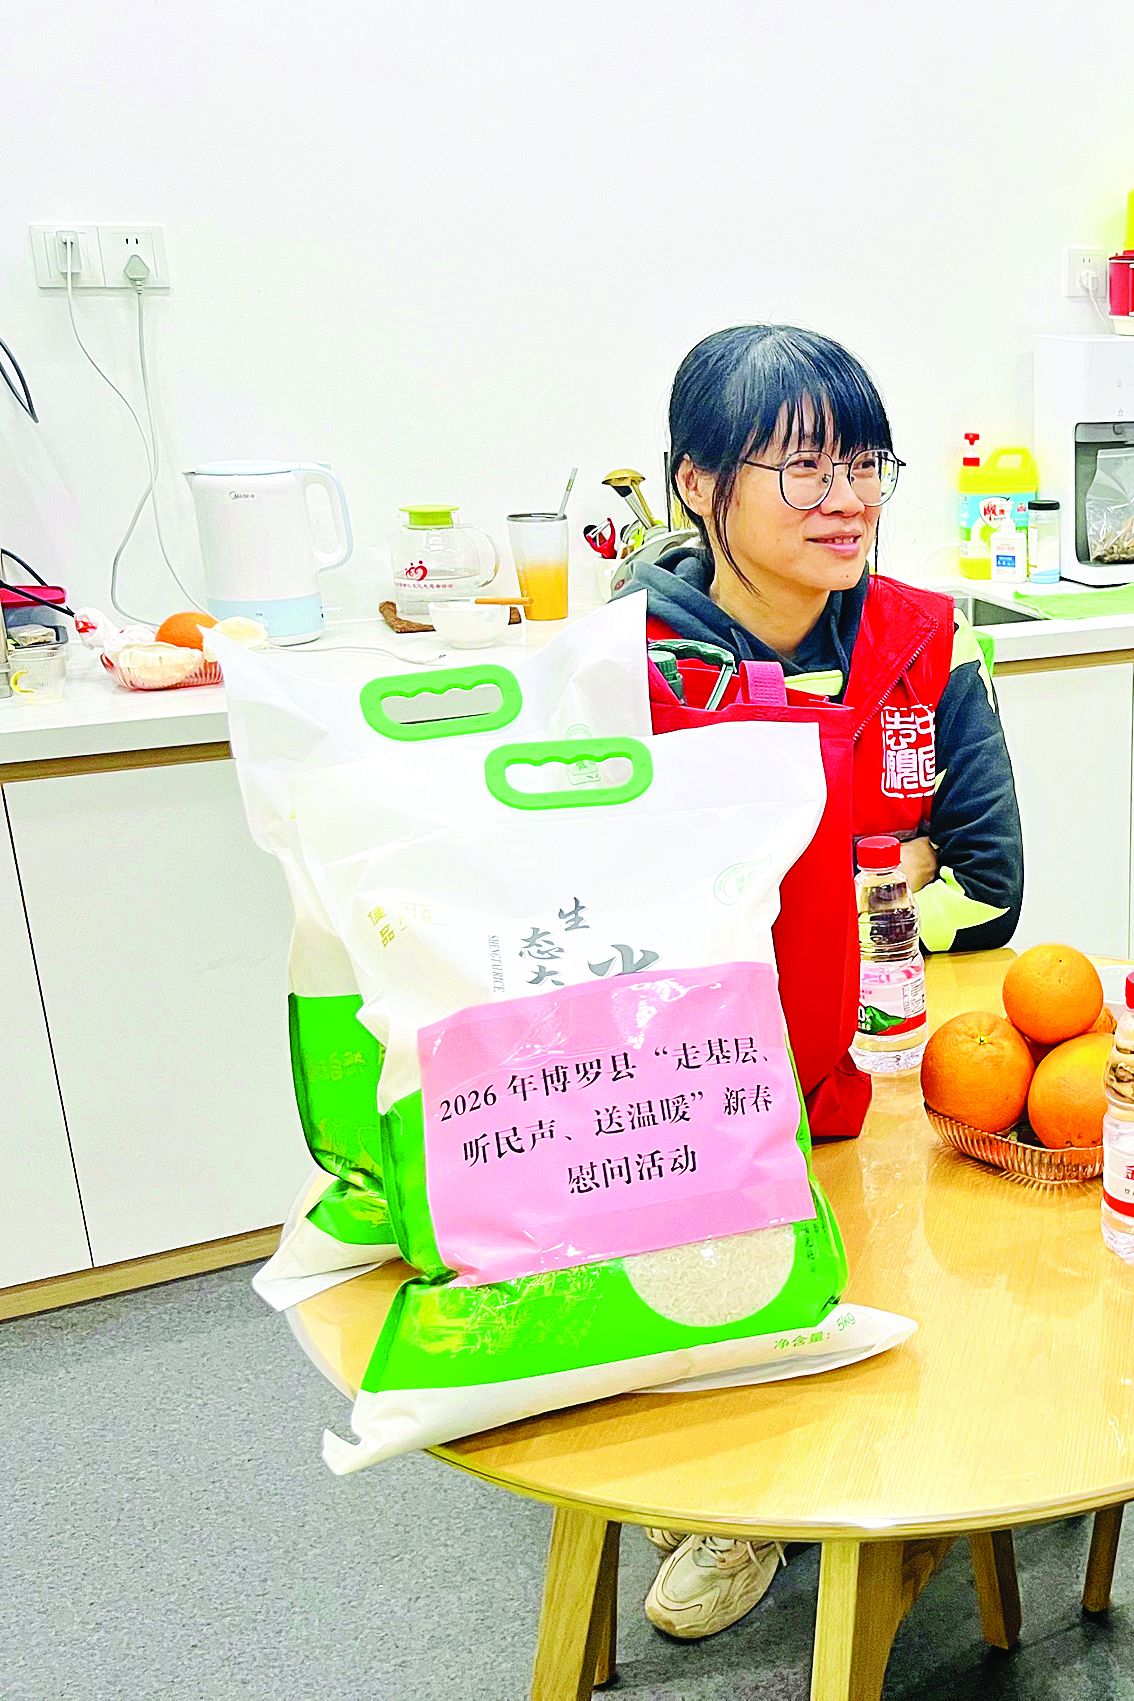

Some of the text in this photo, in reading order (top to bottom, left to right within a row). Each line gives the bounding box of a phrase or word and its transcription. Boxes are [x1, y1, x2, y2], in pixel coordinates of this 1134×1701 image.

[568, 1144, 697, 1194] 慰问活动
[836, 1312, 856, 1331] 5kg
